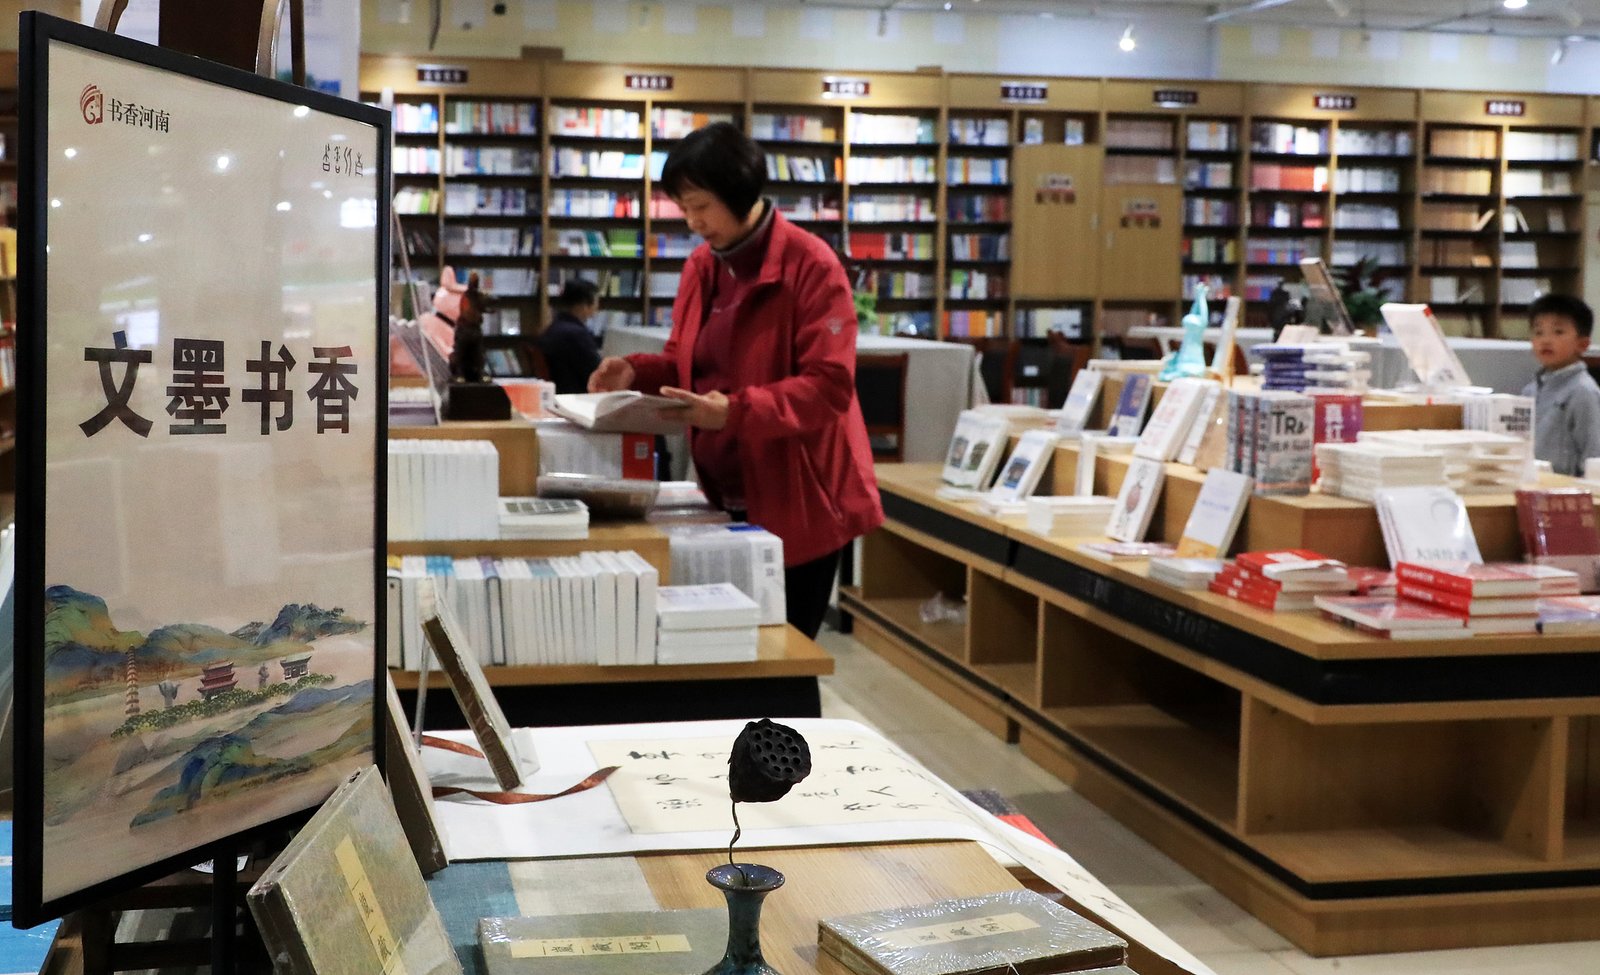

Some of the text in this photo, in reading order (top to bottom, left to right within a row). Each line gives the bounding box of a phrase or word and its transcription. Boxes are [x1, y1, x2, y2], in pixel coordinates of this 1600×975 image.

[107, 98, 170, 133] 书香河南
[78, 331, 359, 438] 文墨书香
